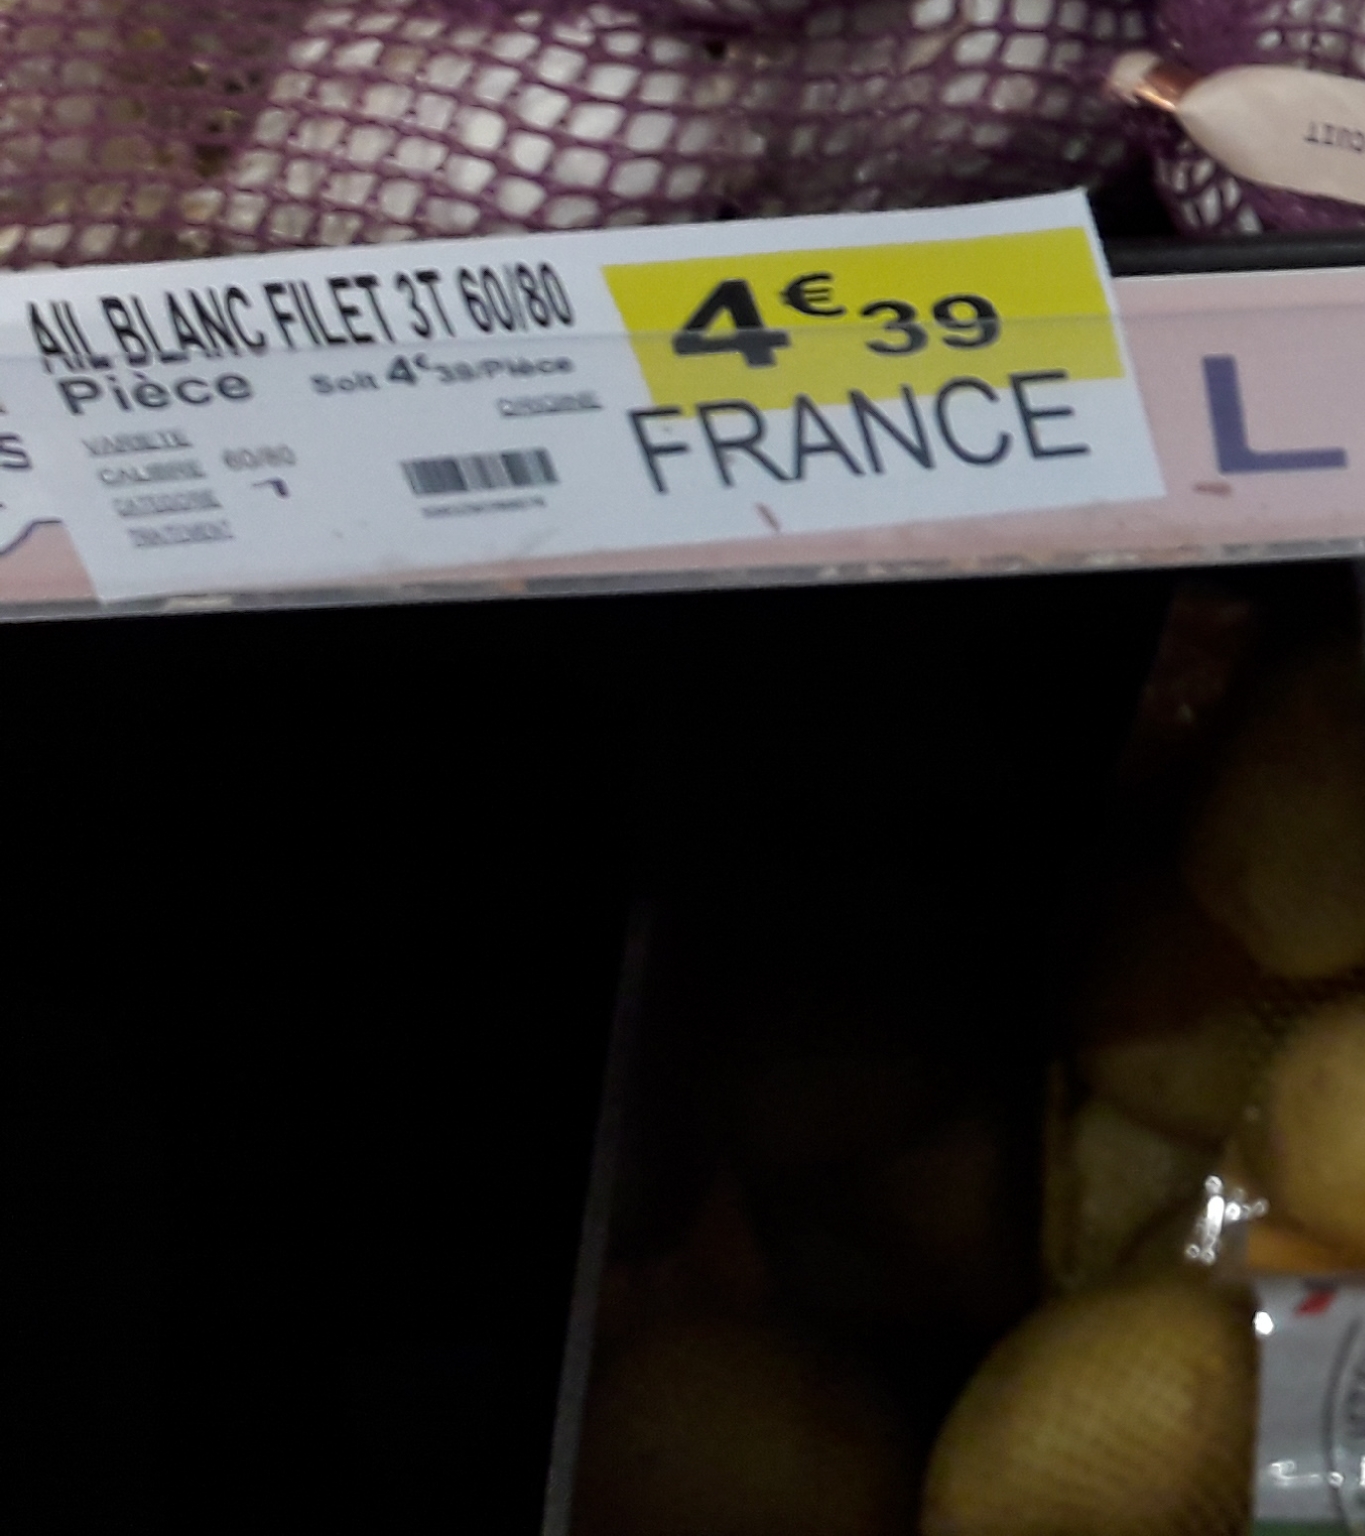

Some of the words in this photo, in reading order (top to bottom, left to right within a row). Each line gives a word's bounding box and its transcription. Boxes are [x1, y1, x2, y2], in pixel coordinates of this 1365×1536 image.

[25, 300, 112, 375] AIL
[100, 286, 268, 365] BLANC
[262, 272, 401, 351] FILET
[394, 269, 458, 339] 3T
[457, 261, 577, 334] 60/80
[55, 371, 255, 416] Pièce
[310, 369, 380, 395] Soit
[626, 368, 1093, 497] FRANCE
[1203, 353, 1348, 475] L
